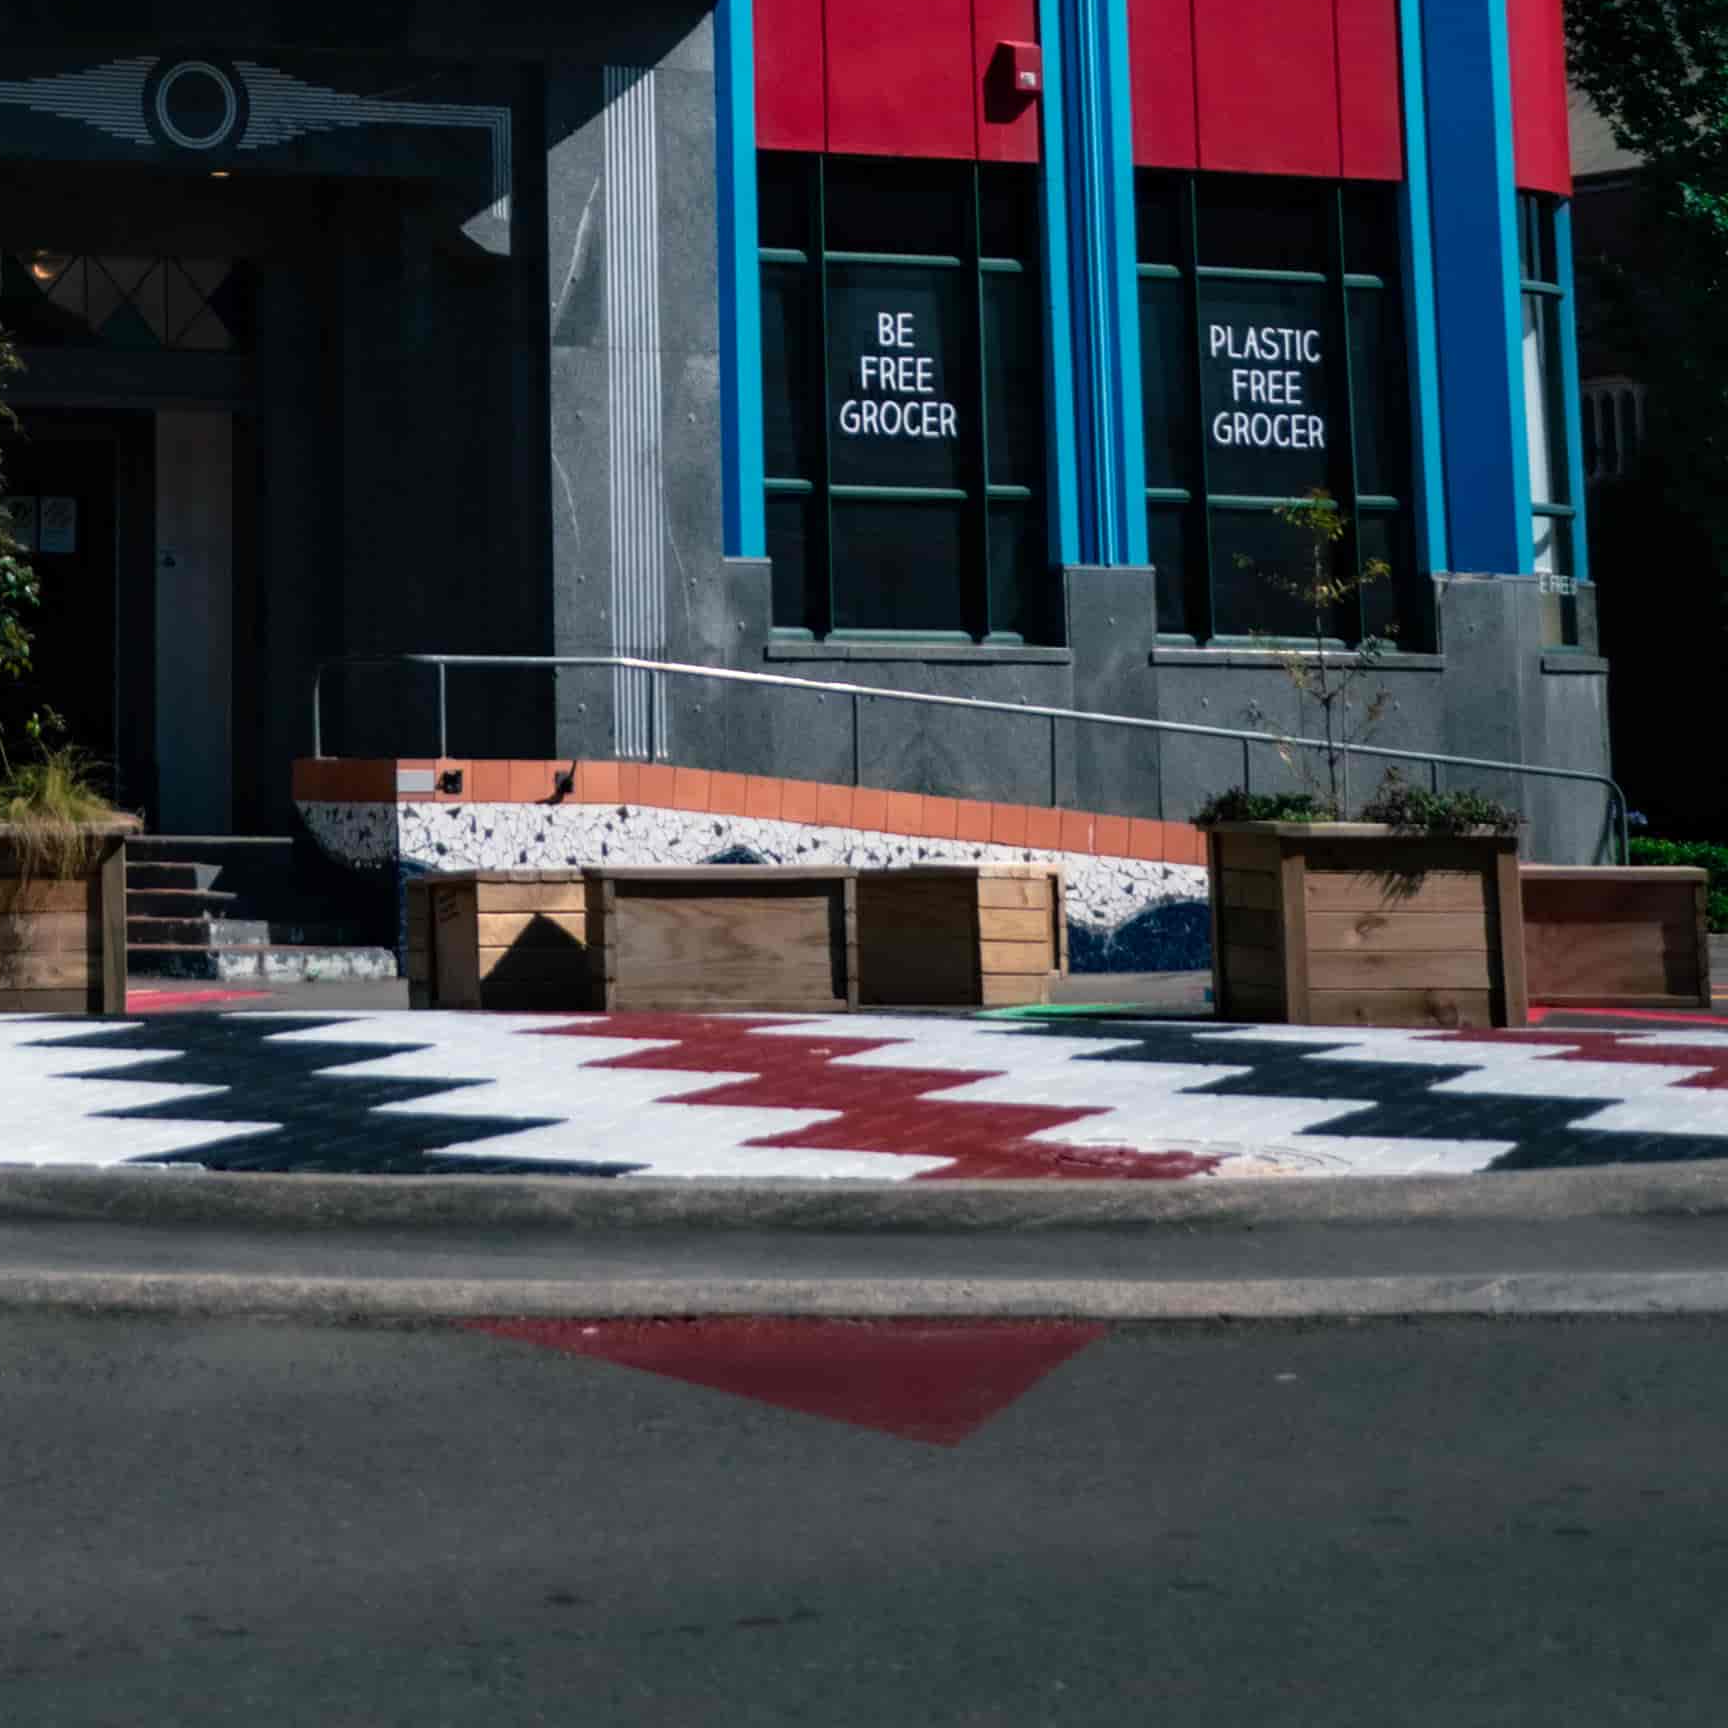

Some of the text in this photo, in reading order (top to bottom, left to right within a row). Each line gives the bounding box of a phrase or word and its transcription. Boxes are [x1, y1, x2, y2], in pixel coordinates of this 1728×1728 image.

[878, 312, 915, 346] BE
[1208, 324, 1321, 363] PLASTIC
[860, 355, 934, 393] FREE
[1231, 369, 1302, 406] FREE
[839, 399, 958, 437] GROCER
[1213, 411, 1326, 449] GROCER
